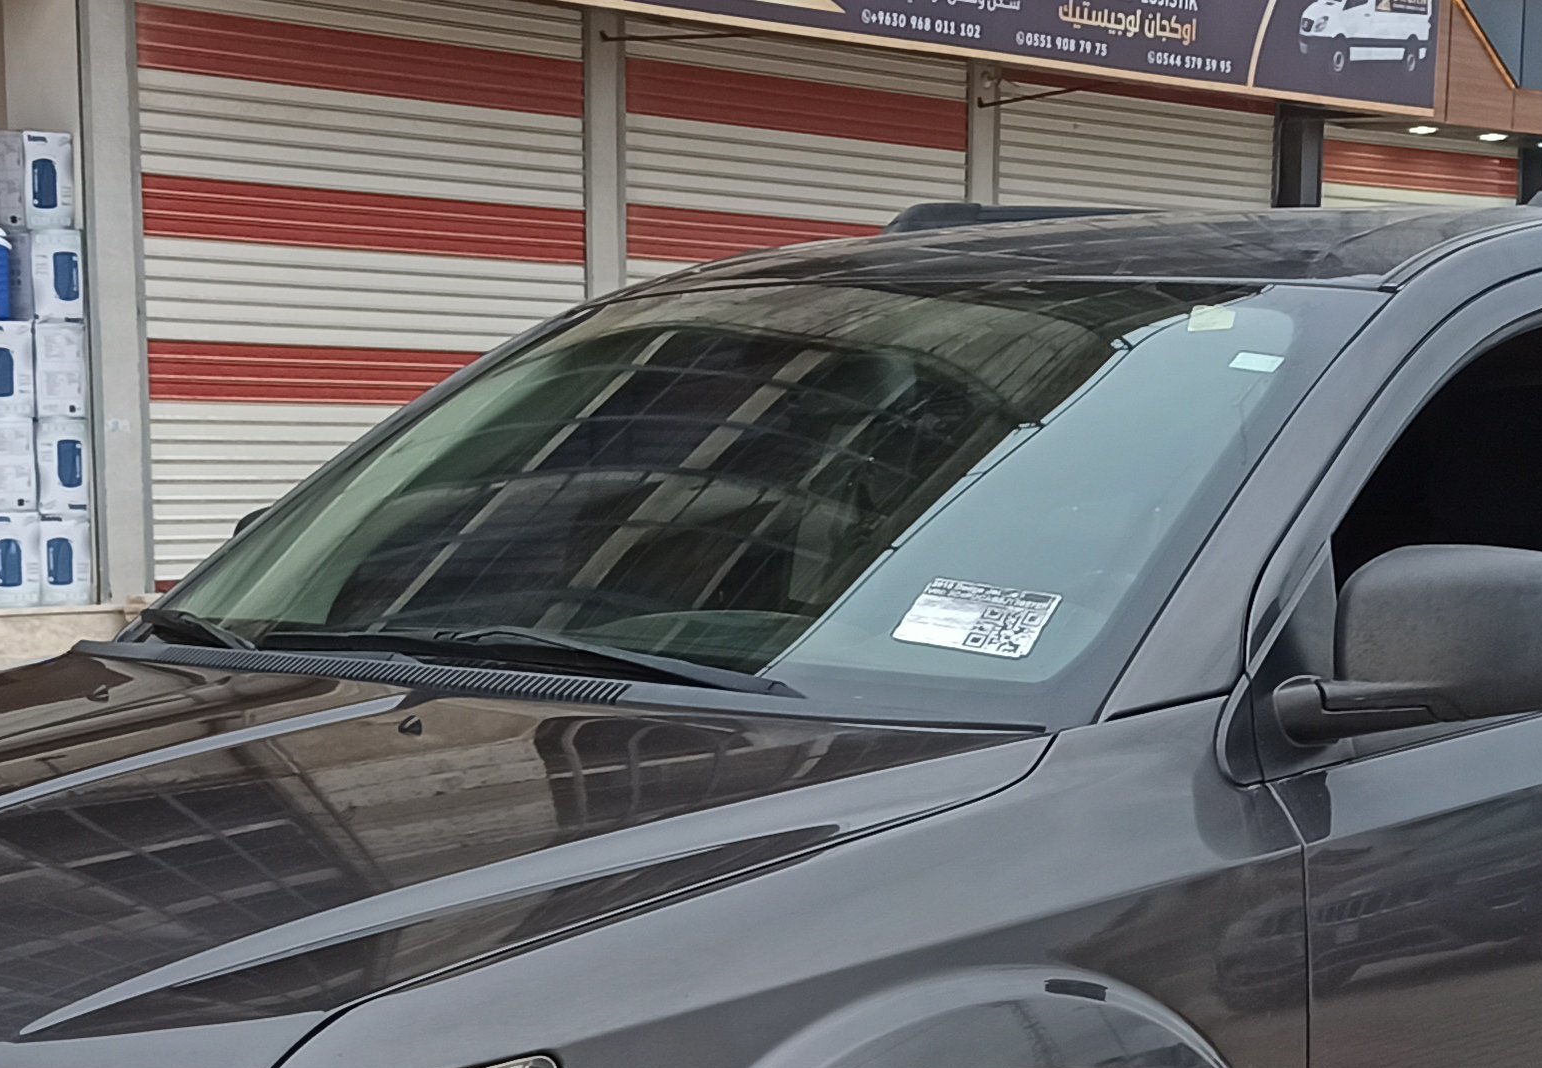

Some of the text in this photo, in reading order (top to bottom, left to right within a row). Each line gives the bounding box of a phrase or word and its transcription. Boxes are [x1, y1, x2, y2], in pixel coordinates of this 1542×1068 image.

[910, 15, 931, 31] 968
[935, 19, 955, 35] 011
[960, 22, 981, 39] 102
[1059, 0, 1197, 45] اوكجان لوجيستيك
[1025, 33, 1052, 49] 0551
[1079, 40, 1092, 54] 79
[1095, 43, 1108, 57] 75
[1156, 52, 1182, 67] 0544
[1184, 55, 1203, 70] 579
